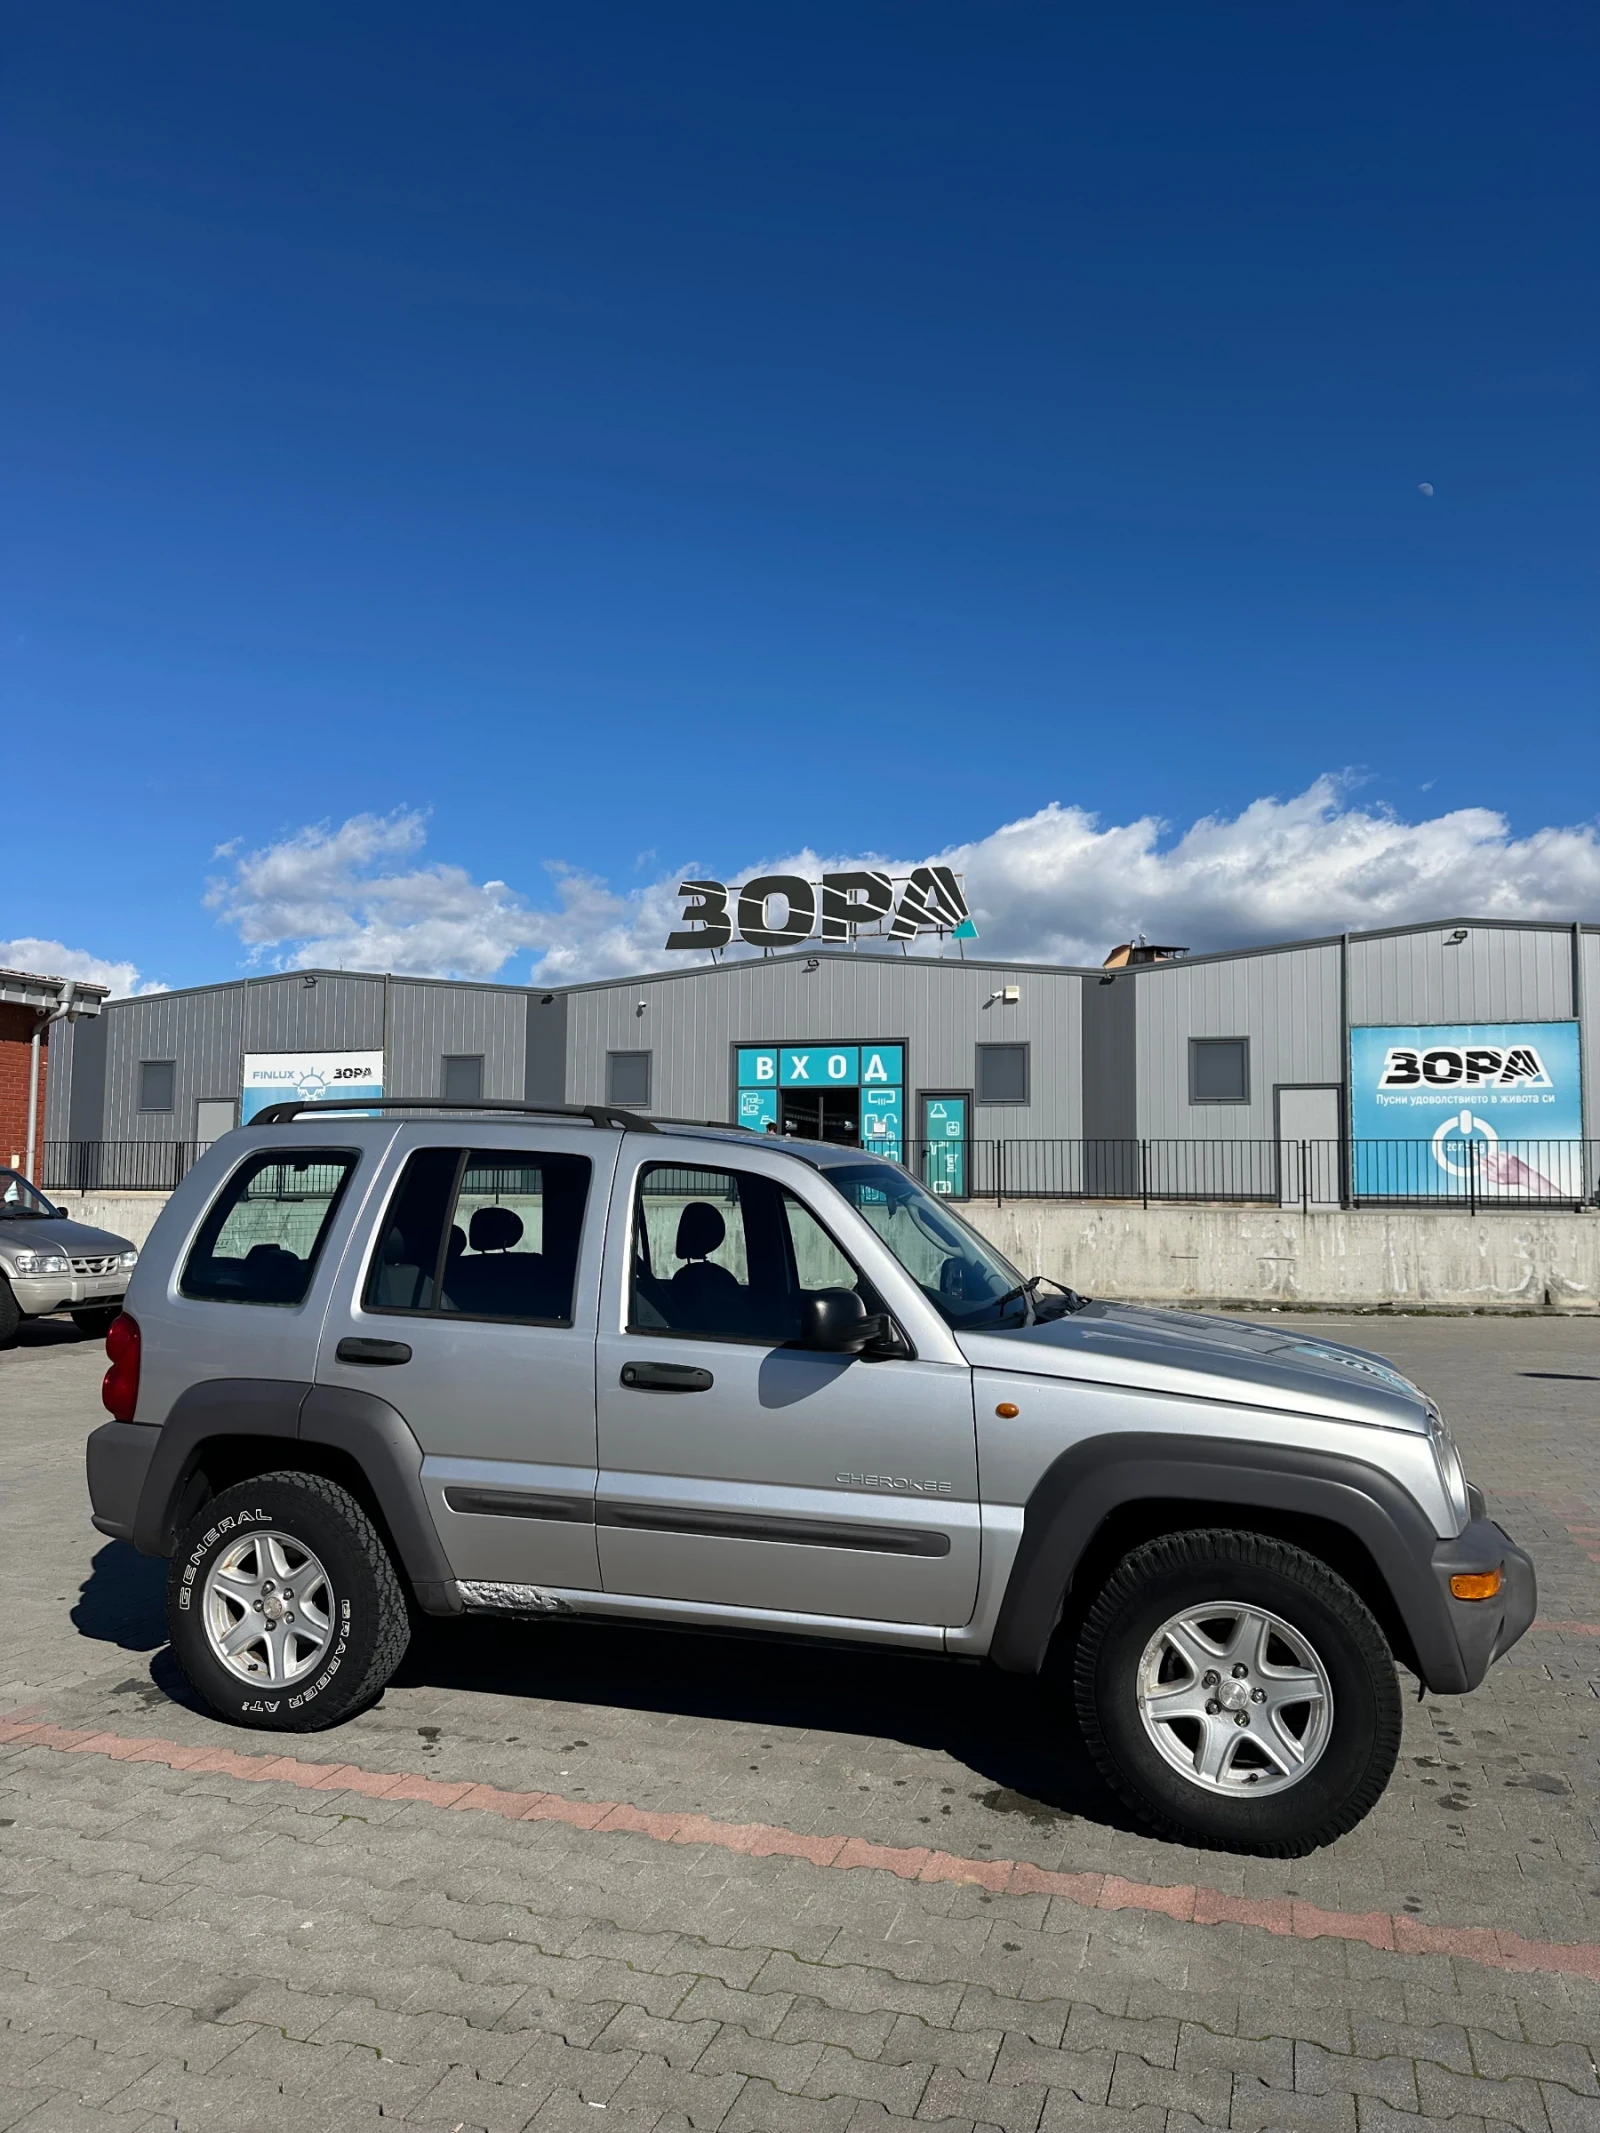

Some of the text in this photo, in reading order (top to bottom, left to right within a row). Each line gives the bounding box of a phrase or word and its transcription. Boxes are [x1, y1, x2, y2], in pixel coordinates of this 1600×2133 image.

[664, 866, 978, 950] ЗОРА
[252, 1070, 295, 1080] FINLUX
[333, 1067, 373, 1080] ЗОРА
[756, 1054, 888, 1082] ВХОД
[1385, 1049, 1544, 1085] ЗОРА
[1376, 1094, 1408, 1106] Пусни
[1411, 1095, 1488, 1106] удоволствието
[1501, 1095, 1539, 1103] живота
[1542, 1094, 1555, 1104] си
[835, 1472, 952, 1493] CHEROKEE
[180, 1508, 273, 1610] GENERAL
[288, 1599, 351, 1709] GRABBER
